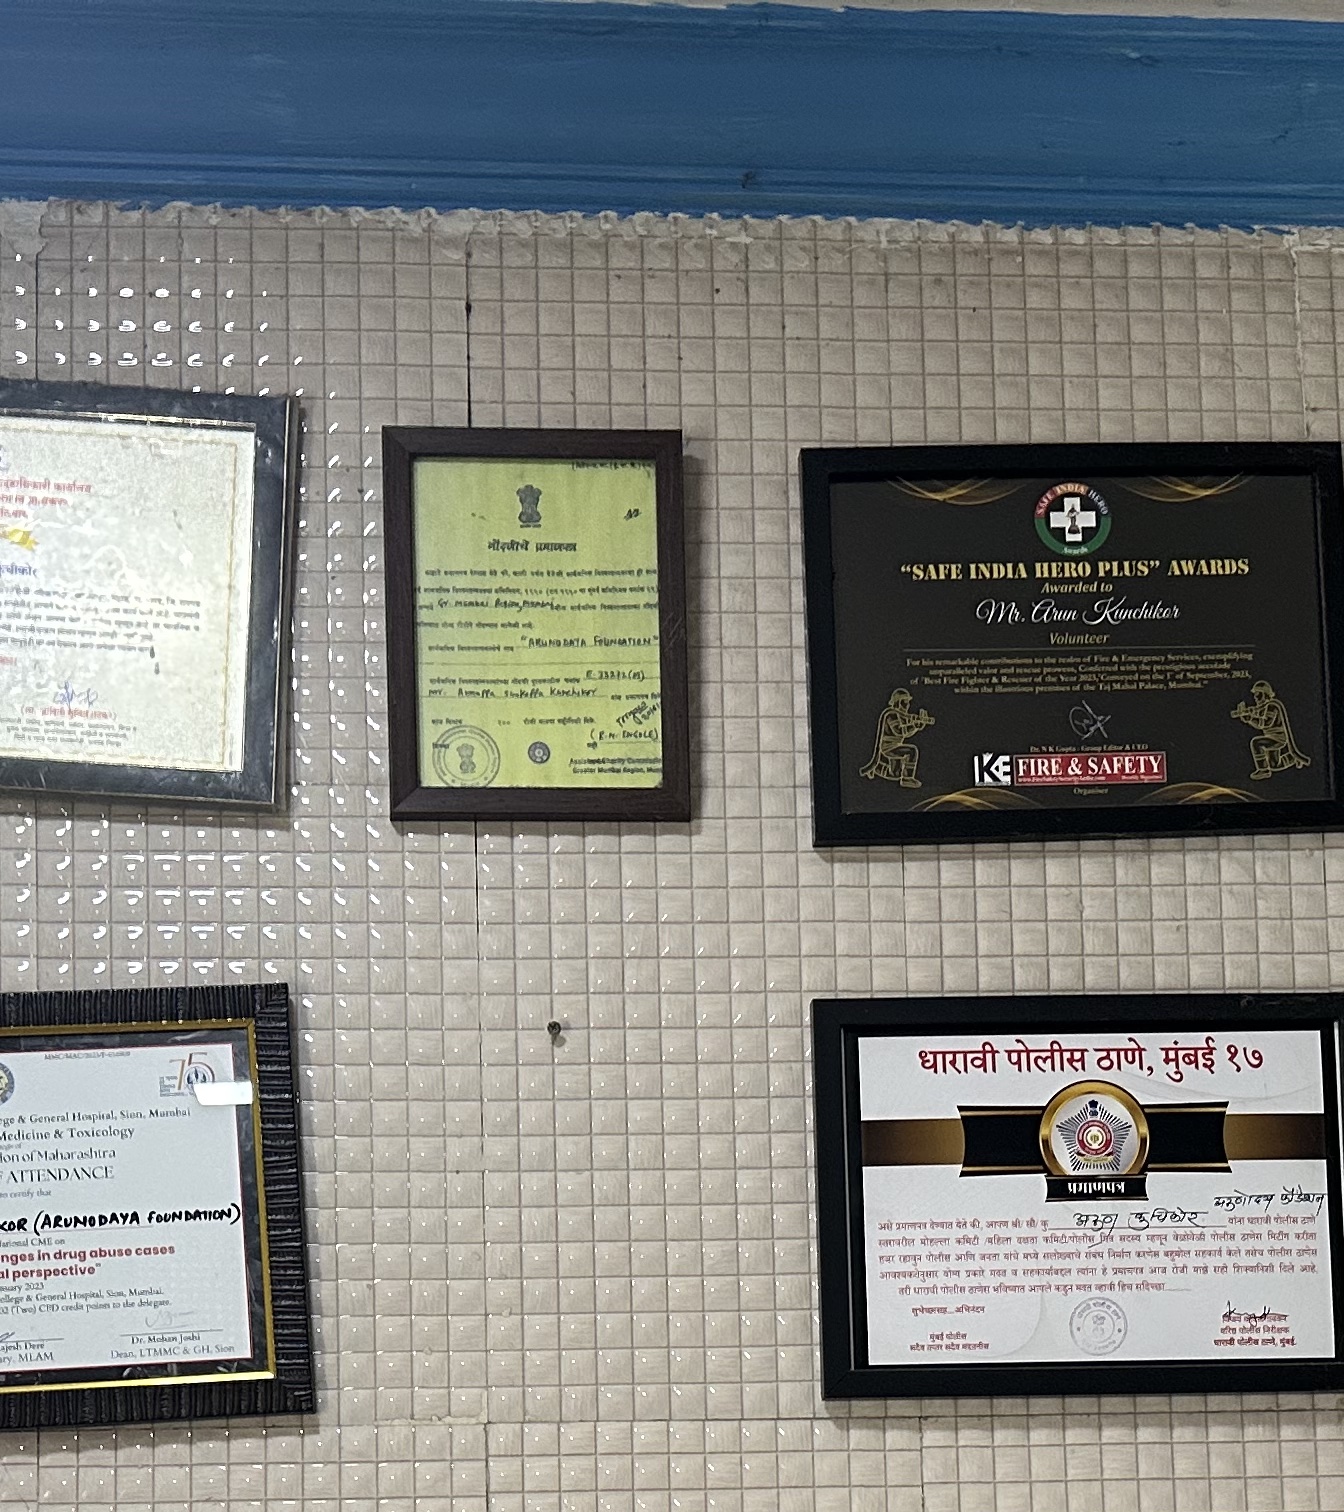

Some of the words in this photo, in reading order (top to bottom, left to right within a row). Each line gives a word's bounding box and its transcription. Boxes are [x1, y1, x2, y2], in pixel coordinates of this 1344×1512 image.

[970, 562, 1027, 579] INDIA
[1035, 562, 1091, 578] HERO
[1167, 559, 1250, 576] AWARDS
[1041, 582, 1098, 594] Awarded
[1100, 582, 1113, 592] to
[975, 599, 1026, 625] Mr.
[1031, 600, 1080, 623] Arun
[1082, 596, 1181, 625] Kunchikor
[1049, 632, 1110, 645] Volunteer
[1017, 759, 1064, 776] FIRE
[1068, 758, 1083, 775] &
[1088, 755, 1162, 775] SAFETY
[918, 1041, 998, 1075] धारावी
[1005, 1039, 1087, 1074] पोलीस
[1096, 1037, 1155, 1077] ठाणे,
[1162, 1037, 1216, 1082] मुंबई
[1226, 1043, 1264, 1070] १७
[54, 1128, 64, 1139] &
[68, 1126, 135, 1141] Toxicology
[21, 1150, 37, 1164] of
[37, 1147, 116, 1163] Maharashtra
[6, 1165, 115, 1184] ATTENDANCE
[32, 1209, 140, 1237] (ARUNODAYA
[148, 1202, 242, 1226] FOUNDATION)
[37, 1250, 50, 1262] in
[54, 1248, 87, 1265] drug
[89, 1246, 132, 1260] abuse
[135, 1244, 176, 1257] cases
